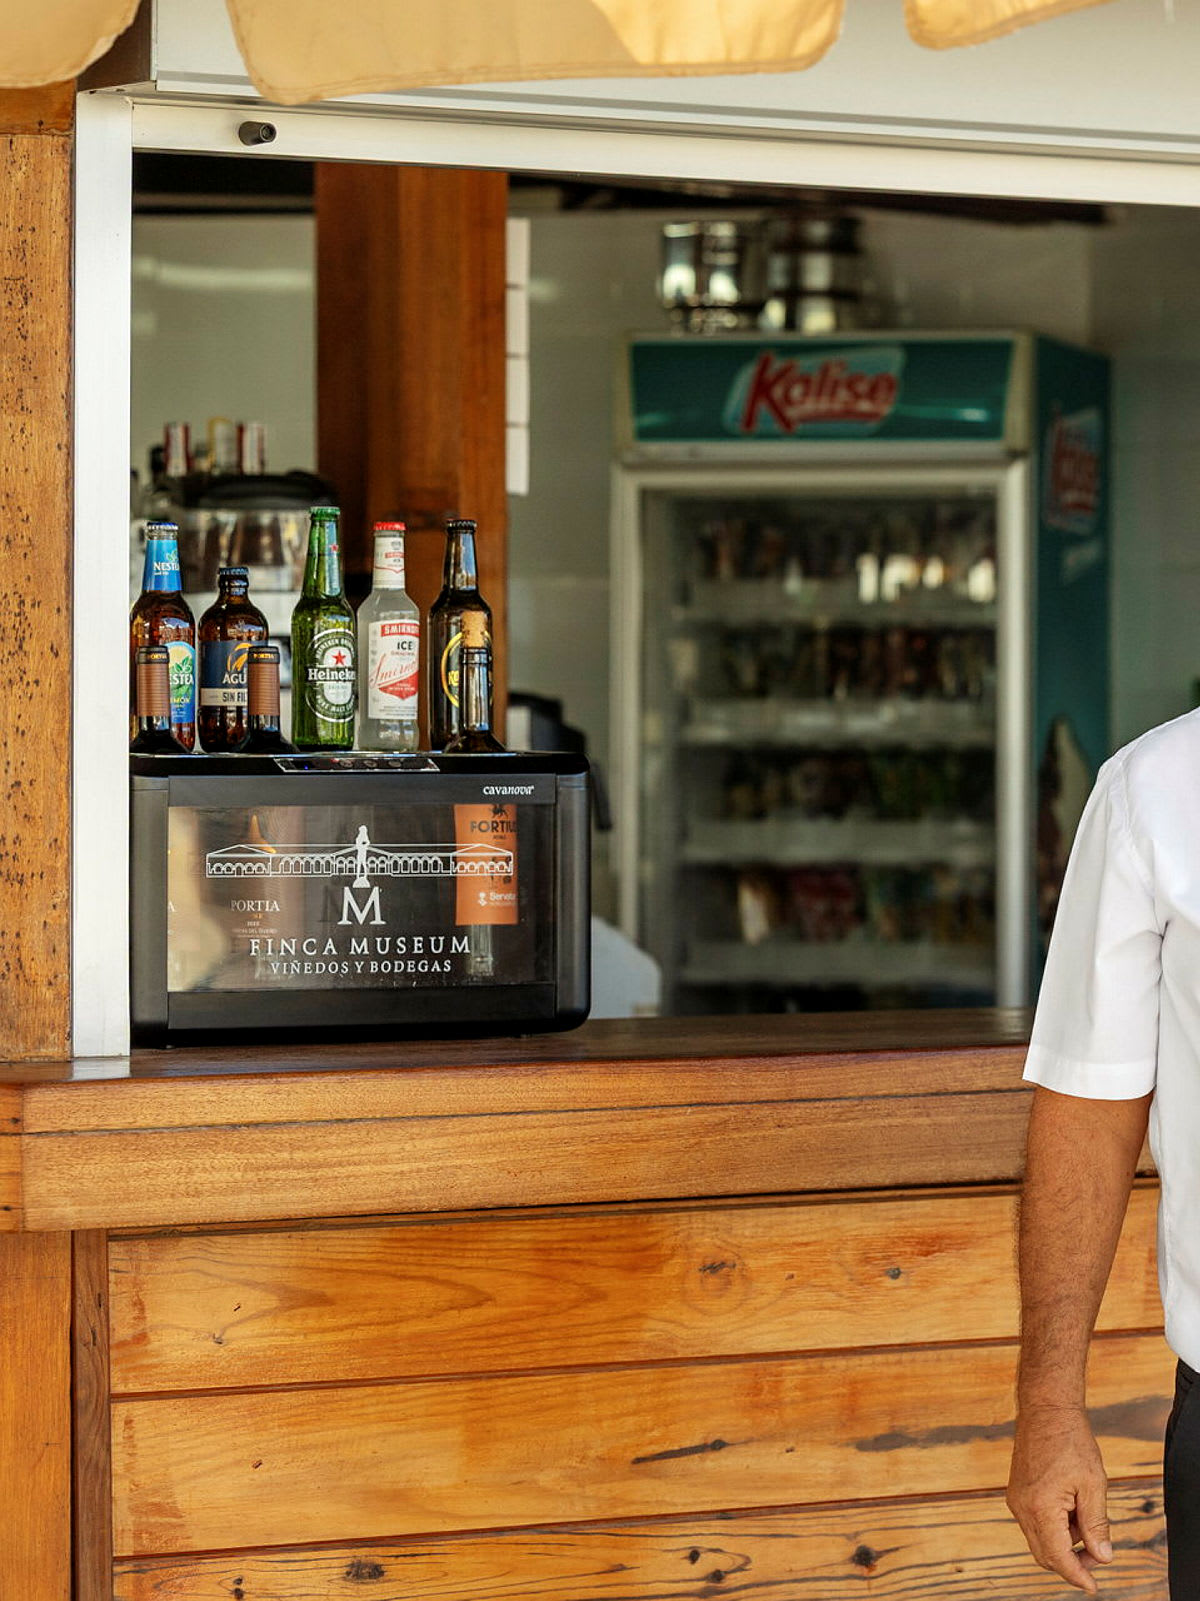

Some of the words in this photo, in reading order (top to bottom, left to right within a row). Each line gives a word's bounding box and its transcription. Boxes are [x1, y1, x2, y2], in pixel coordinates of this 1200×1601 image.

[741, 350, 898, 434] Kalise
[396, 641, 412, 650] ICE
[470, 821, 516, 833] FORTIU
[230, 900, 280, 912] PORTIA
[337, 886, 386, 925] M
[249, 938, 338, 956] FINCA
[349, 936, 471, 955] MUSEUM
[270, 959, 349, 974] VIÑEDOS
[355, 960, 365, 974] Y
[370, 959, 451, 973] BODEGAS
